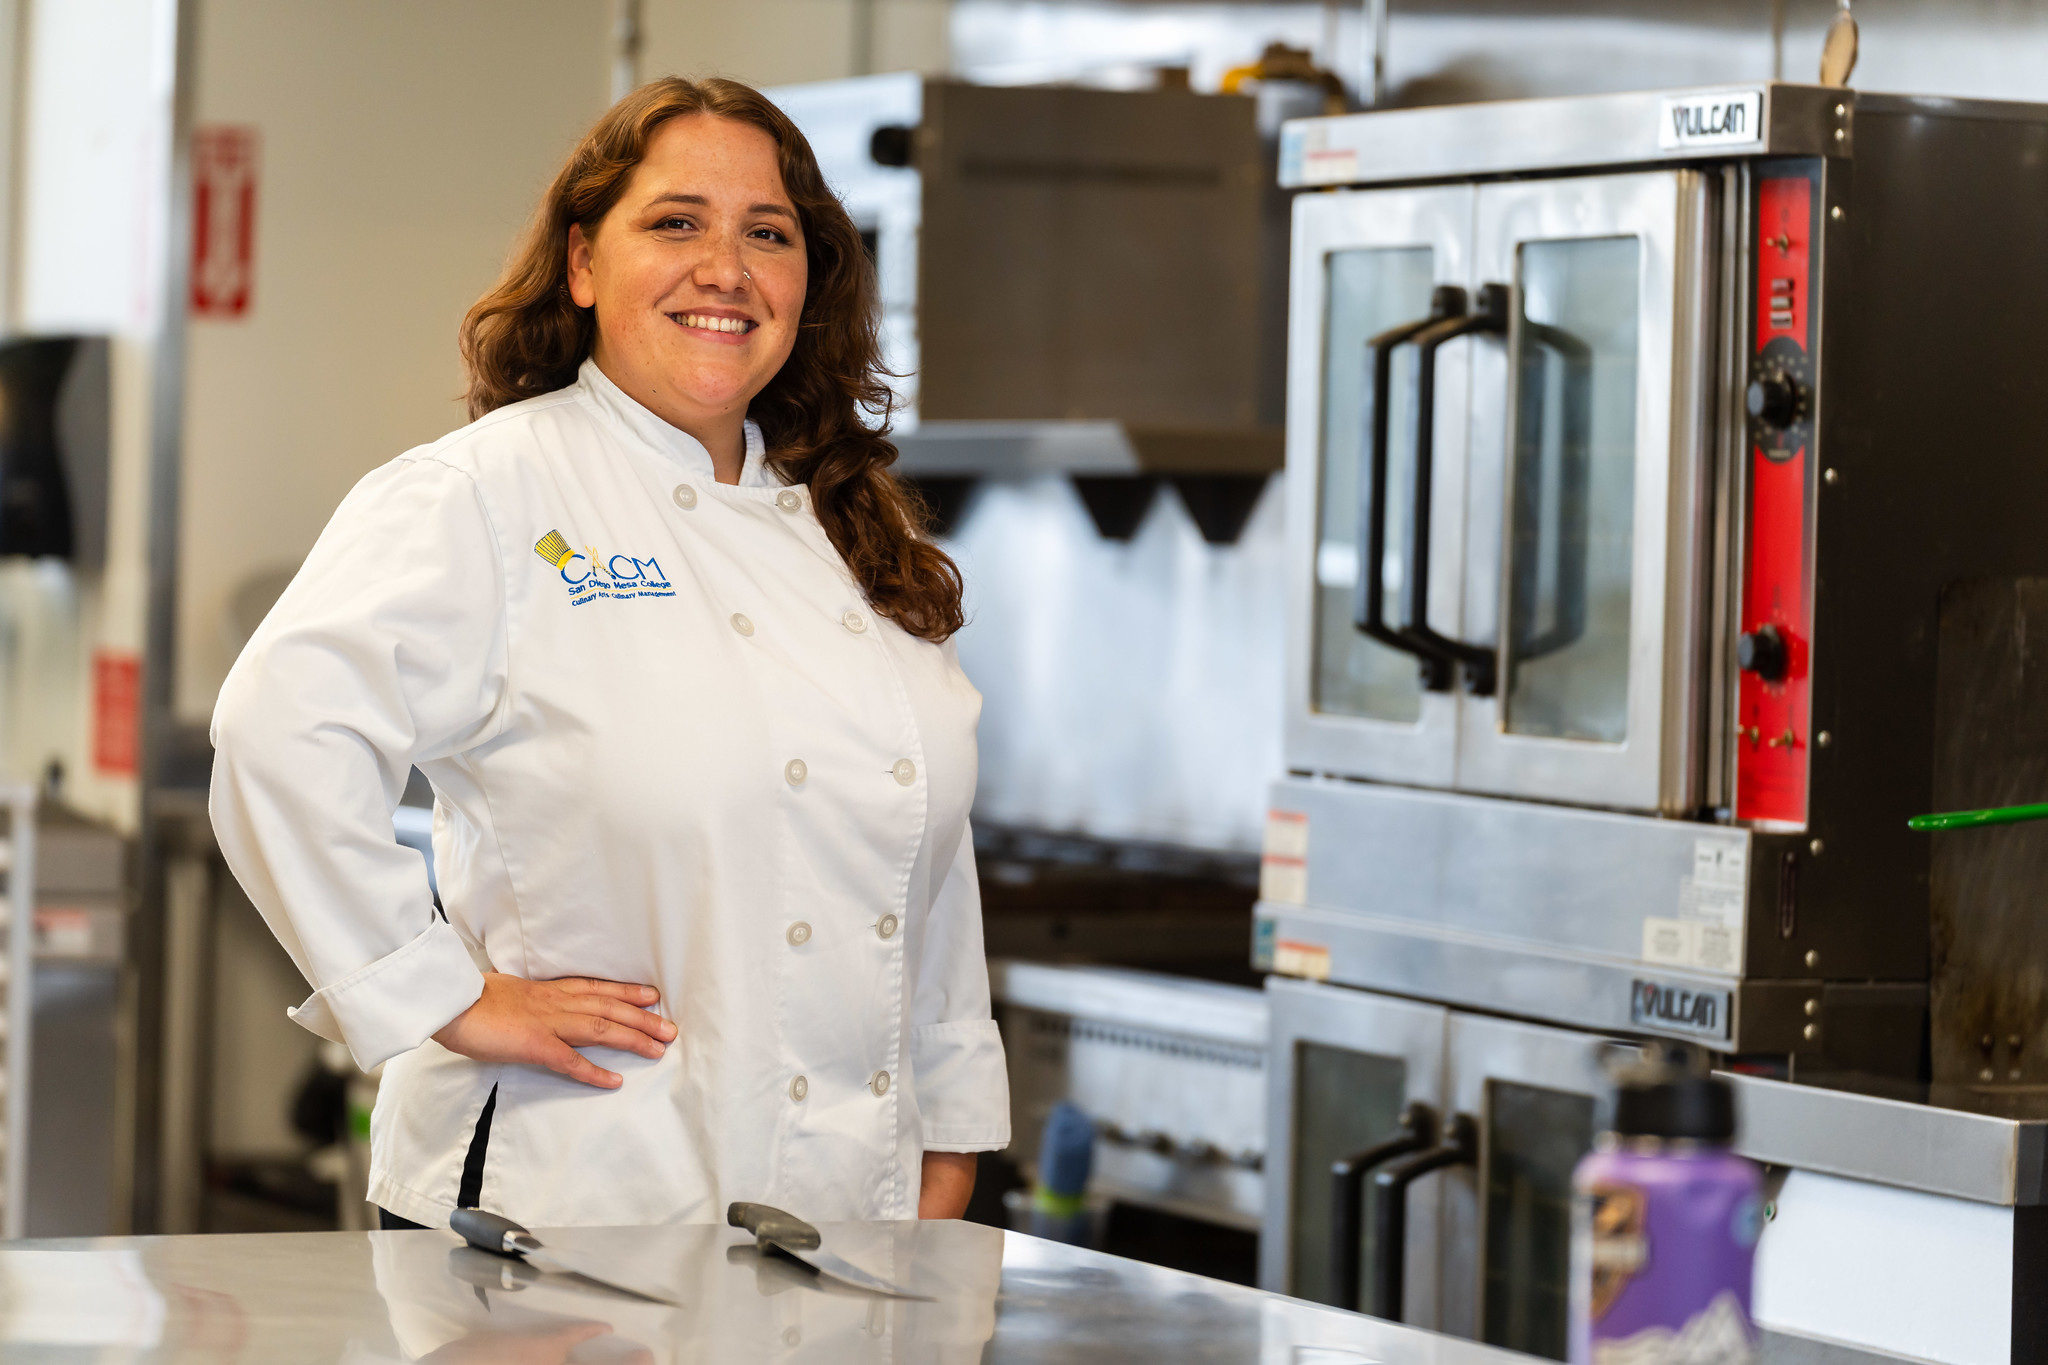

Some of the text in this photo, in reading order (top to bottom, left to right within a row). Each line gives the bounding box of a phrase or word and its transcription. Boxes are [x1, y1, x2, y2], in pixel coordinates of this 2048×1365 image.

[1672, 103, 1745, 138] VULCAN
[568, 579, 672, 596] San Diego Mesa College
[571, 593, 597, 607] Culinary
[611, 592, 636, 600] Culinary
[637, 590, 677, 598] Management
[1642, 983, 1717, 1028] VULCAN
